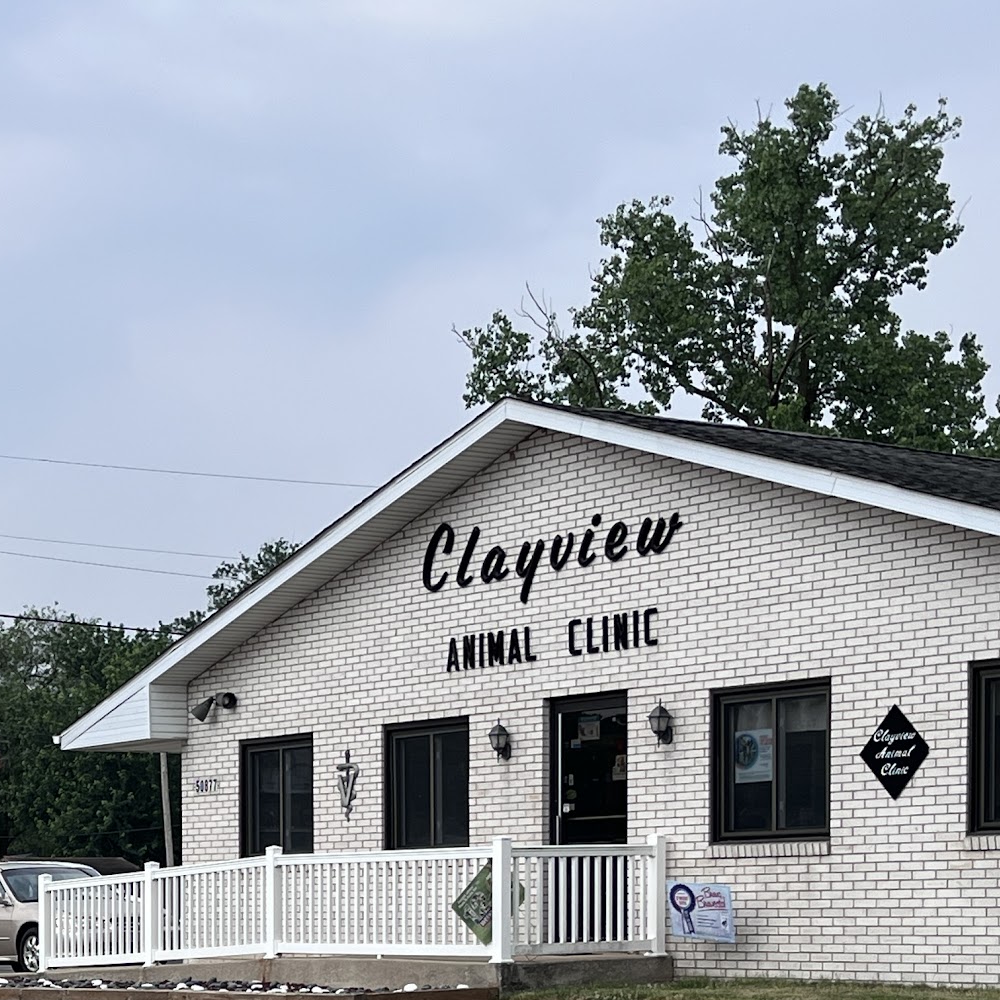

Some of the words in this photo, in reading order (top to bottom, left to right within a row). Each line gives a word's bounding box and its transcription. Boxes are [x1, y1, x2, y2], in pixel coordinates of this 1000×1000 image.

[422, 512, 683, 604] Clayview
[447, 626, 536, 672] ANIMAL
[568, 607, 658, 656] CLINIC
[873, 729, 916, 745] Clayview
[875, 744, 916, 759] Animal
[880, 763, 909, 776] Clinic
